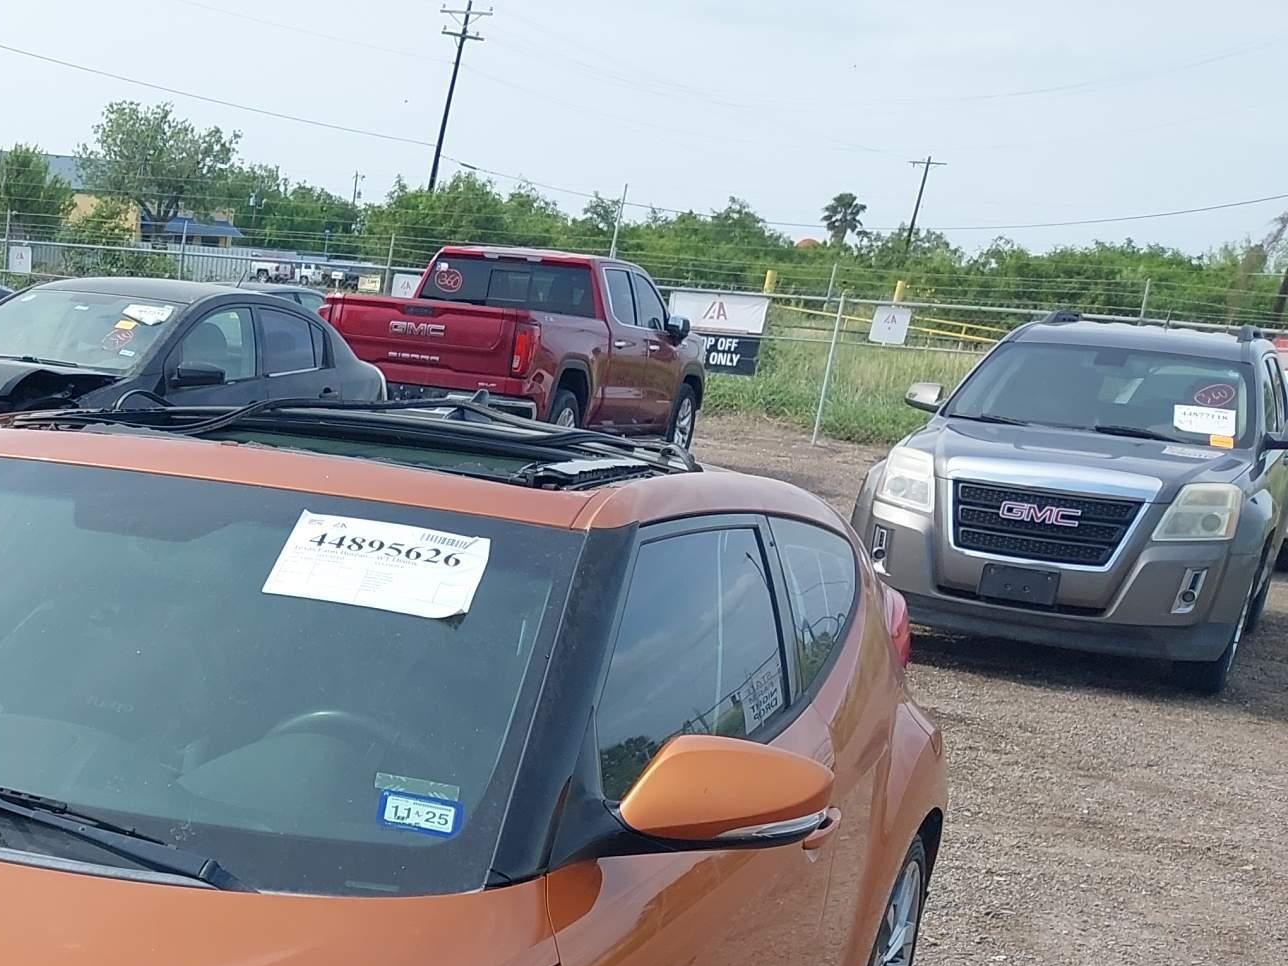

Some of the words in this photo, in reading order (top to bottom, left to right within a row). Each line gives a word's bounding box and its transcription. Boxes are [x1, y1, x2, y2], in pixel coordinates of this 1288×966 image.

[438, 272, 460, 289] 360
[389, 320, 447, 338] GMC
[717, 337, 740, 352] OFF
[709, 351, 741, 367] ONLY
[999, 500, 1083, 528] GMC
[309, 532, 465, 568] 44895626
[391, 804, 412, 820] 11
[423, 810, 449, 826] 25
